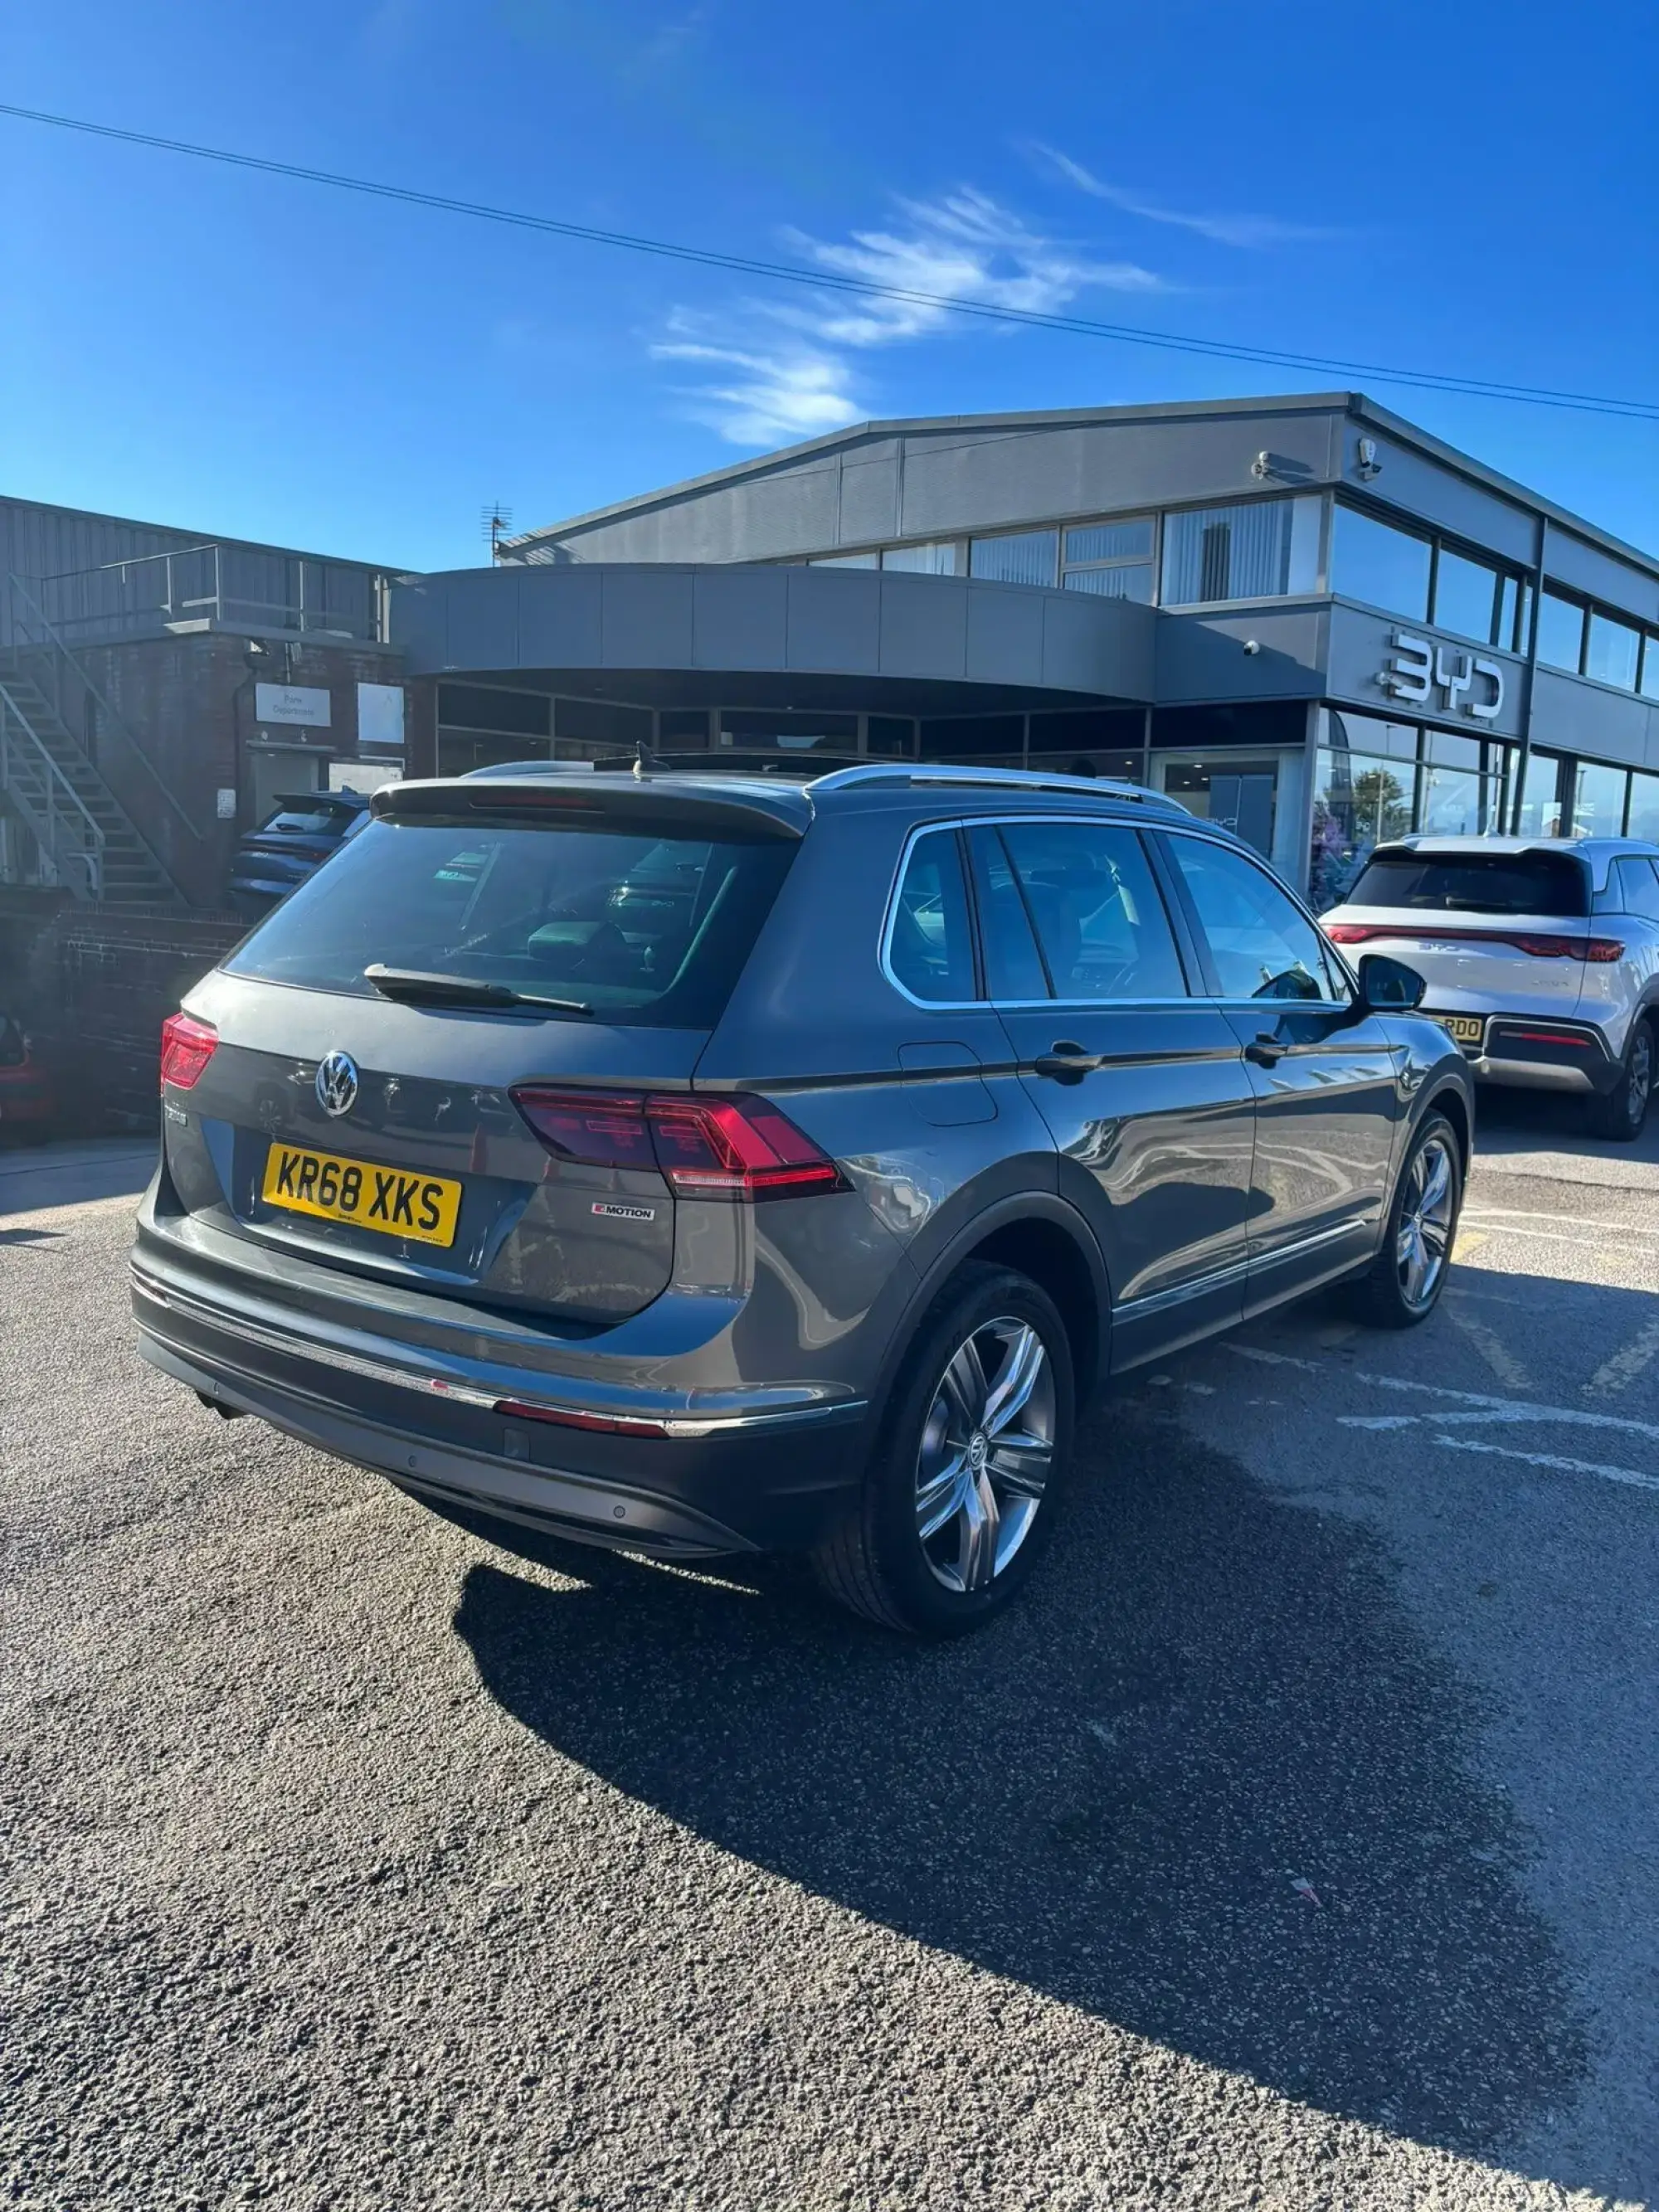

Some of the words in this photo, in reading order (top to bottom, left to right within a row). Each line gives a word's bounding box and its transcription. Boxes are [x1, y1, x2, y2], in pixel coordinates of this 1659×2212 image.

[1390, 634, 1505, 719] BYD
[276, 1151, 362, 1212] KR68
[368, 1171, 444, 1231] XKS
